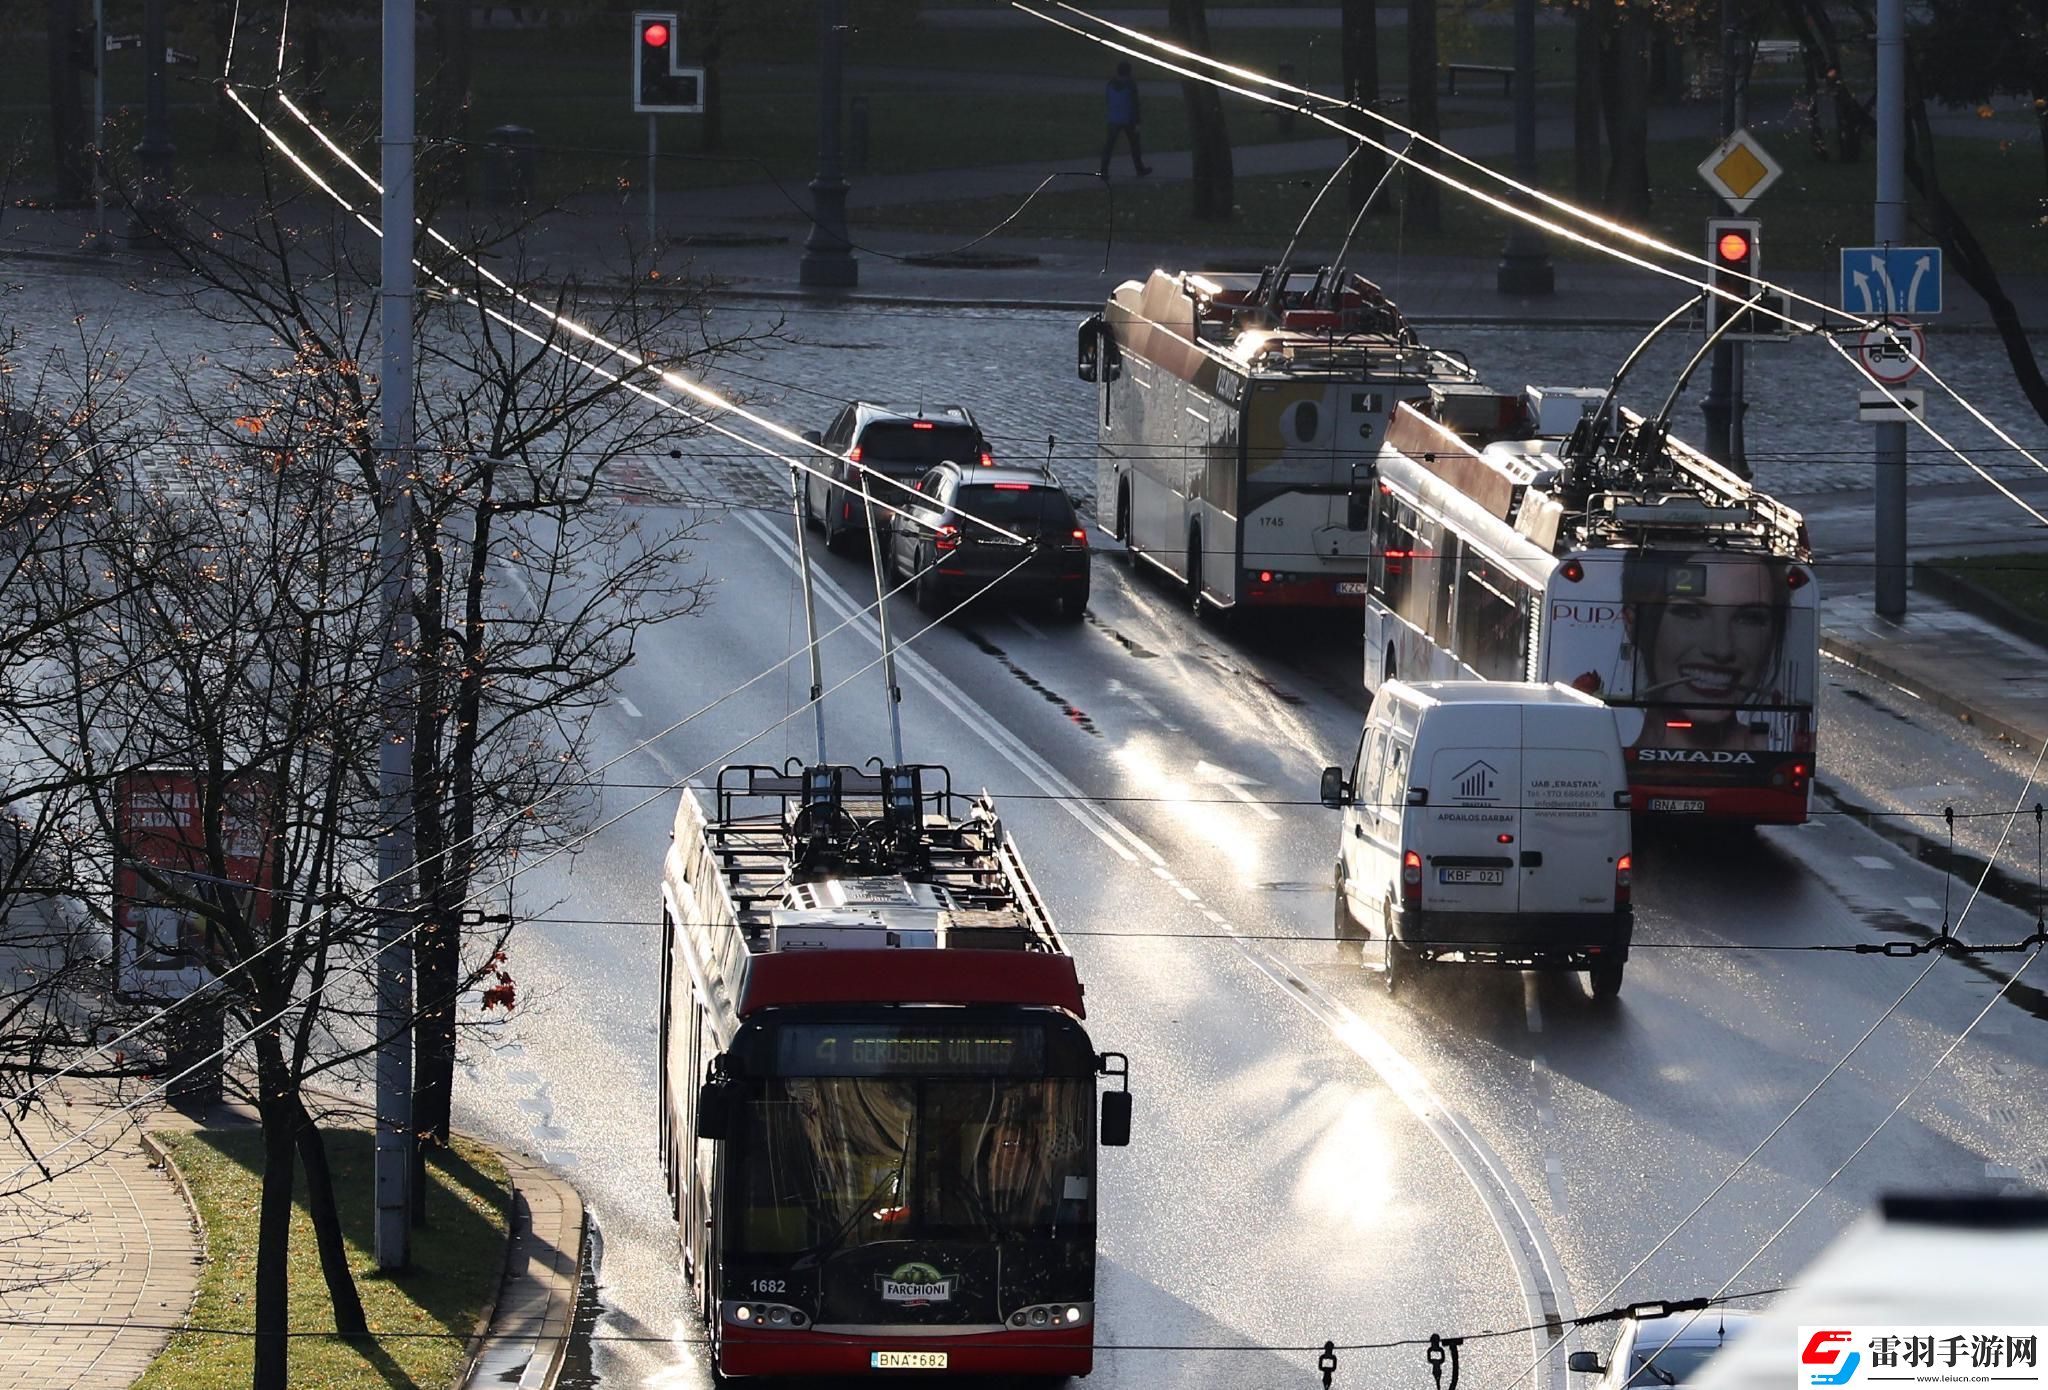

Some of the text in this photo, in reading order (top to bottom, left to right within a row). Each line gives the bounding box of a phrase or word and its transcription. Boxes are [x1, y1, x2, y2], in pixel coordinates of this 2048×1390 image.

[1362, 393, 1371, 411] 4
[1260, 517, 1284, 527] 1745
[1676, 570, 1692, 590] 2
[1639, 749, 1756, 764] SMADA
[1447, 870, 1500, 882] KBF 021
[816, 1038, 836, 1064] 4
[750, 1280, 786, 1293] 1682
[887, 1284, 945, 1295] FARCHIONI
[880, 1354, 945, 1367] BNA 682
